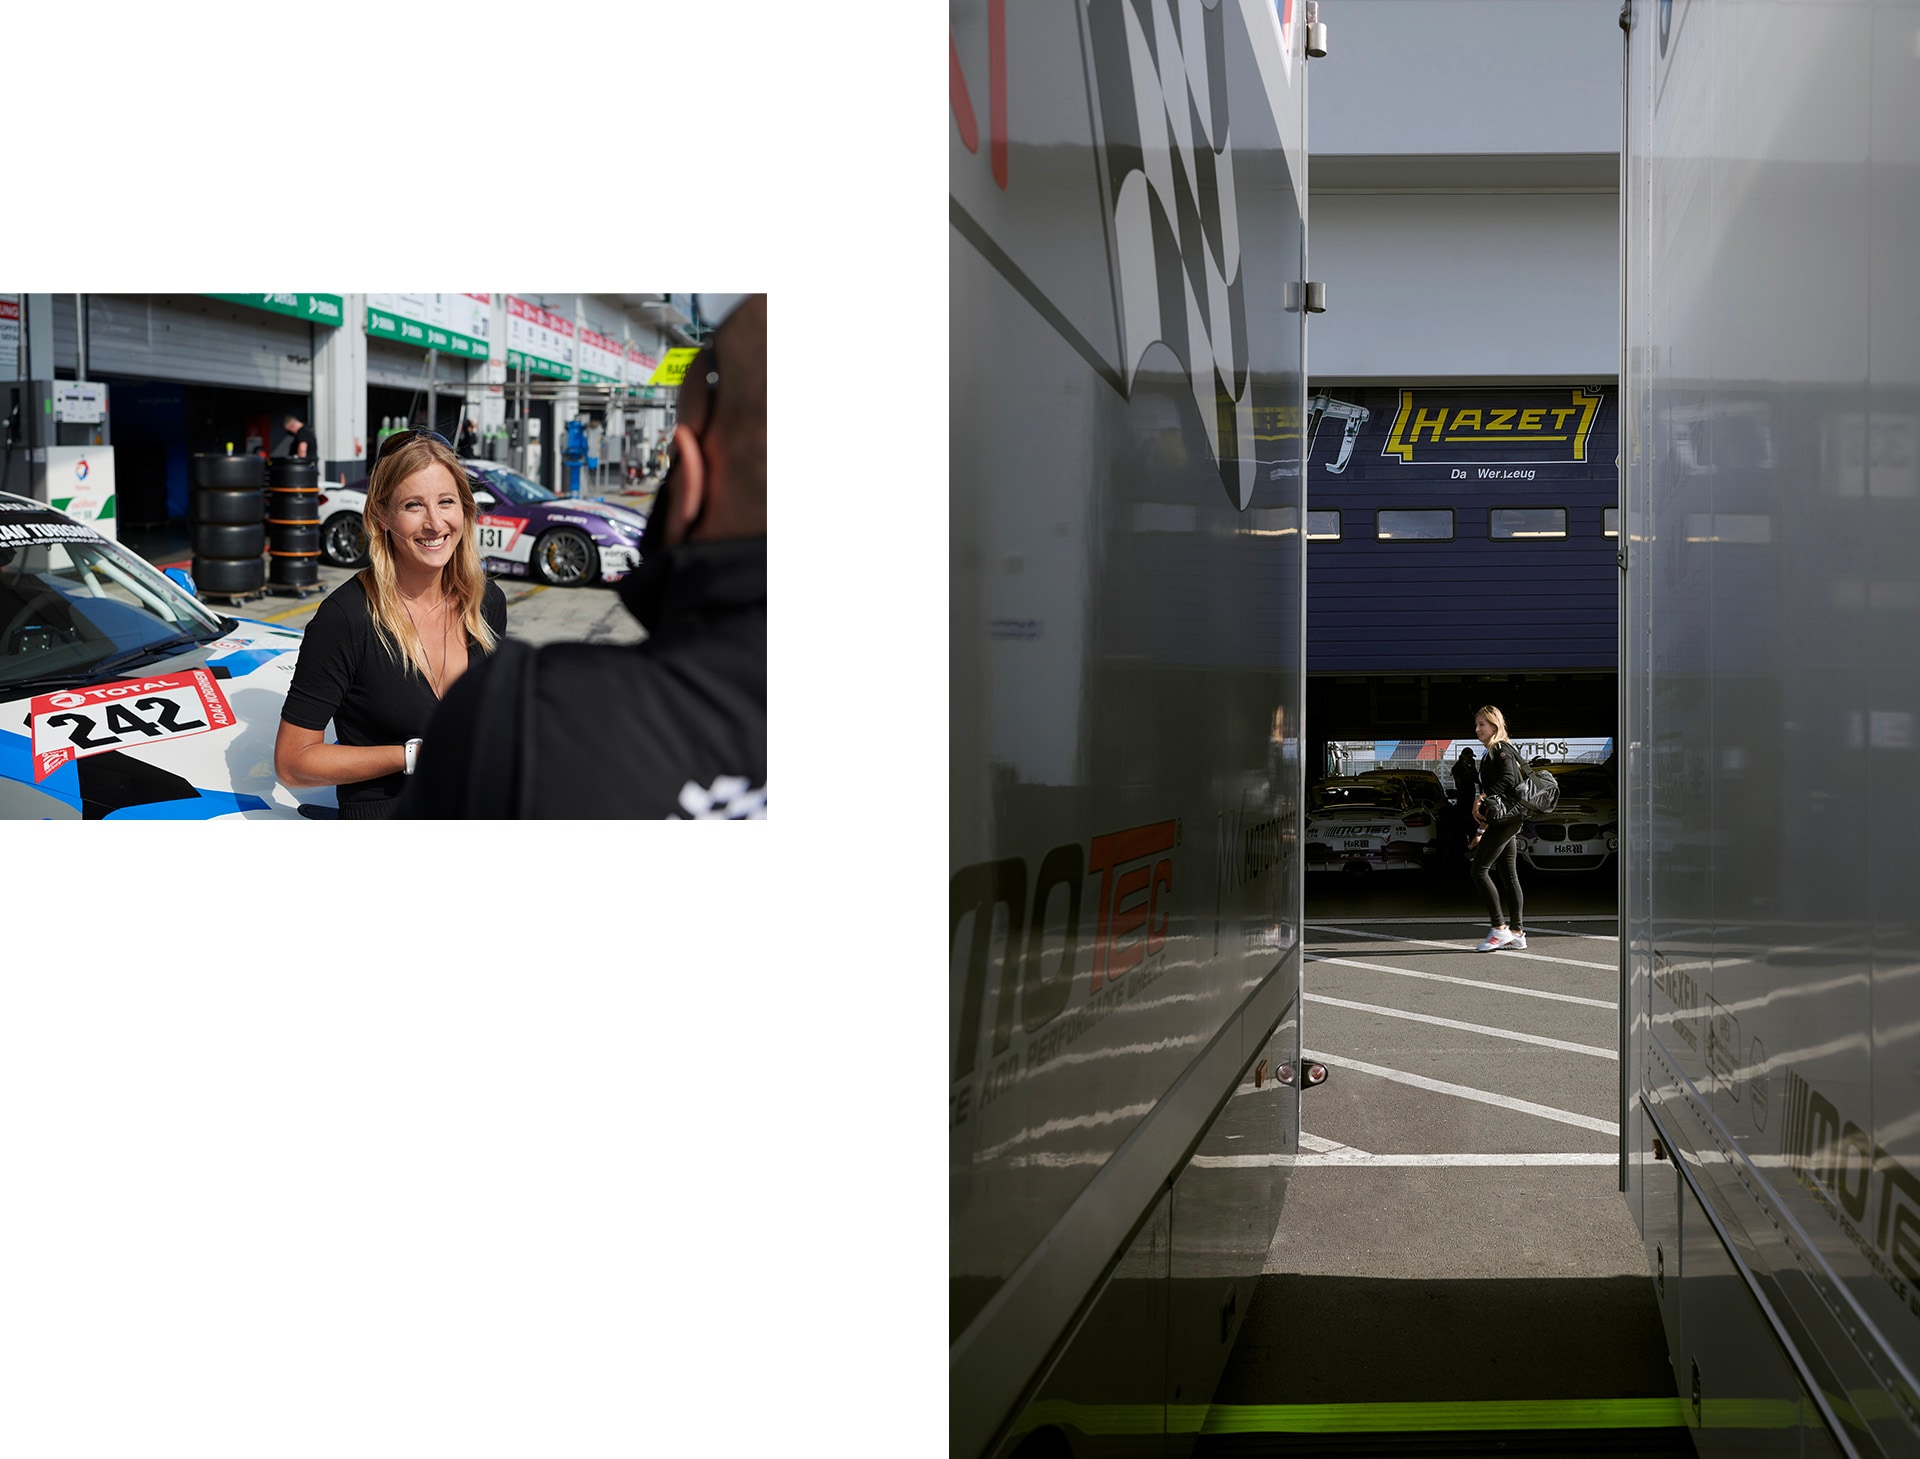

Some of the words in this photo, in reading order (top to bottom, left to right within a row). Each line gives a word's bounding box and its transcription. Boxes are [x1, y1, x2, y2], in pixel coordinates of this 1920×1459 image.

[1409, 408, 1576, 442] HAZET
[25, 523, 99, 539] TURISMO
[480, 529, 502, 548] 131
[85, 680, 179, 699] TOTAL
[47, 697, 207, 750] 242
[207, 702, 229, 725] ADAC
[1665, 957, 1698, 1027] NEXEN
